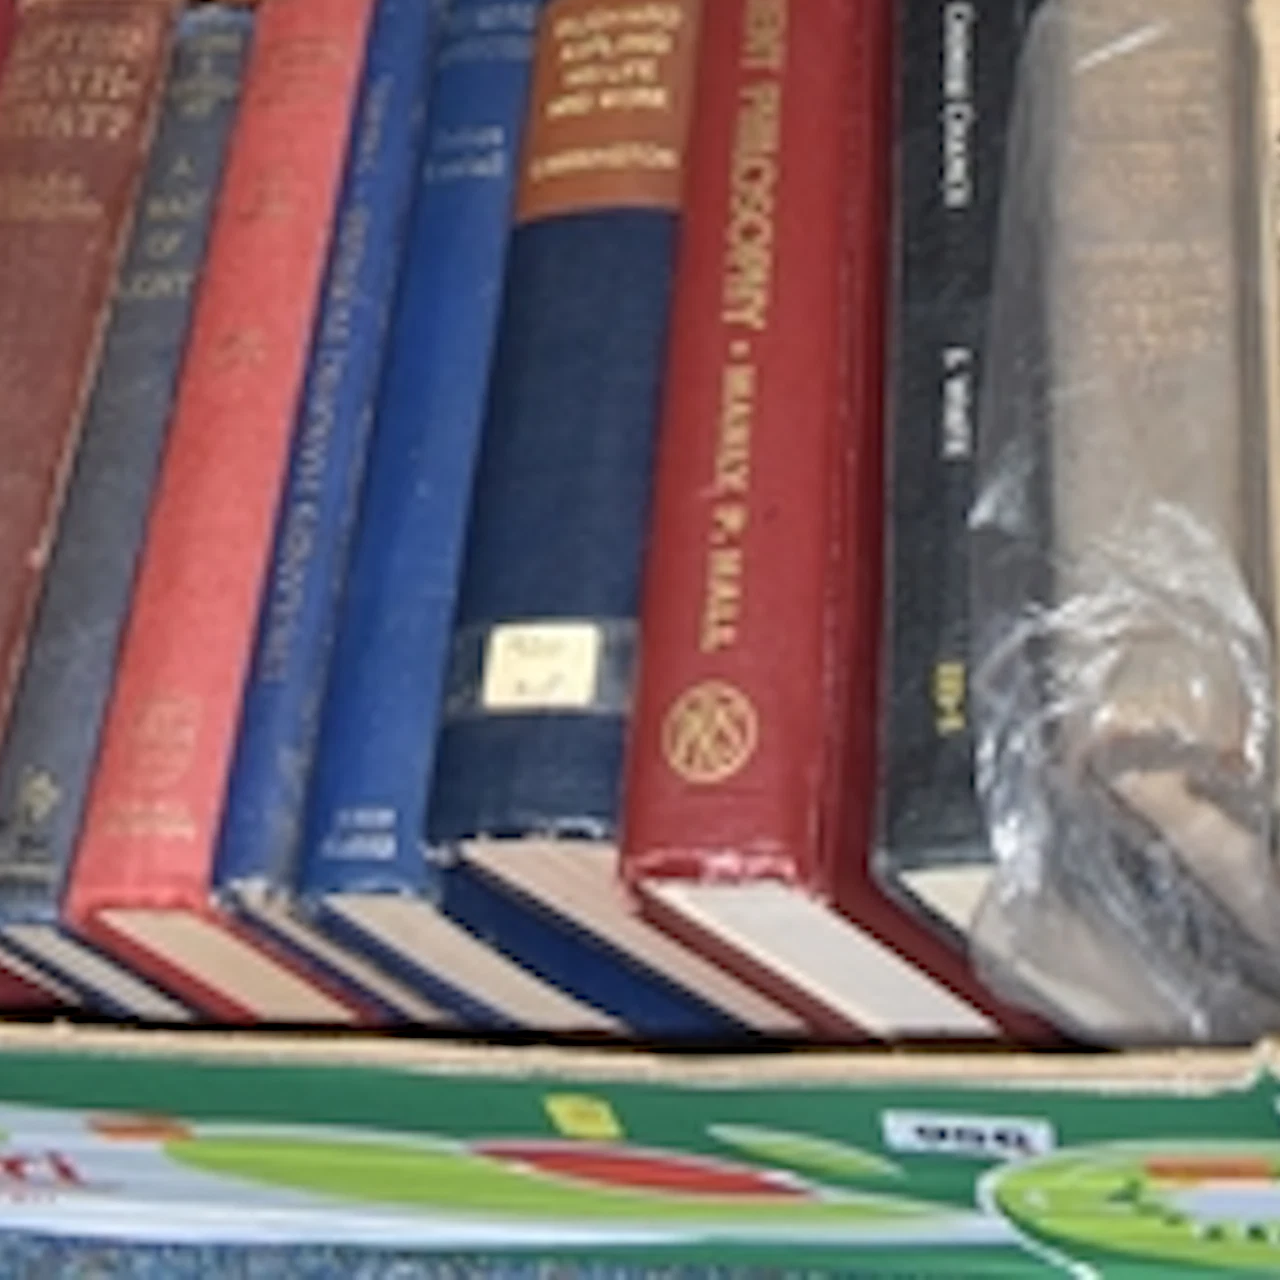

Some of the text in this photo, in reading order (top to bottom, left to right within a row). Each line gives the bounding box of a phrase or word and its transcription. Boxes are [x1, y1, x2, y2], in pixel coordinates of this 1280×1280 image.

[721, 83, 781, 331] PHILOSOPHY
[716, 364, 758, 493] MANLY
[698, 549, 743, 654] HALL
